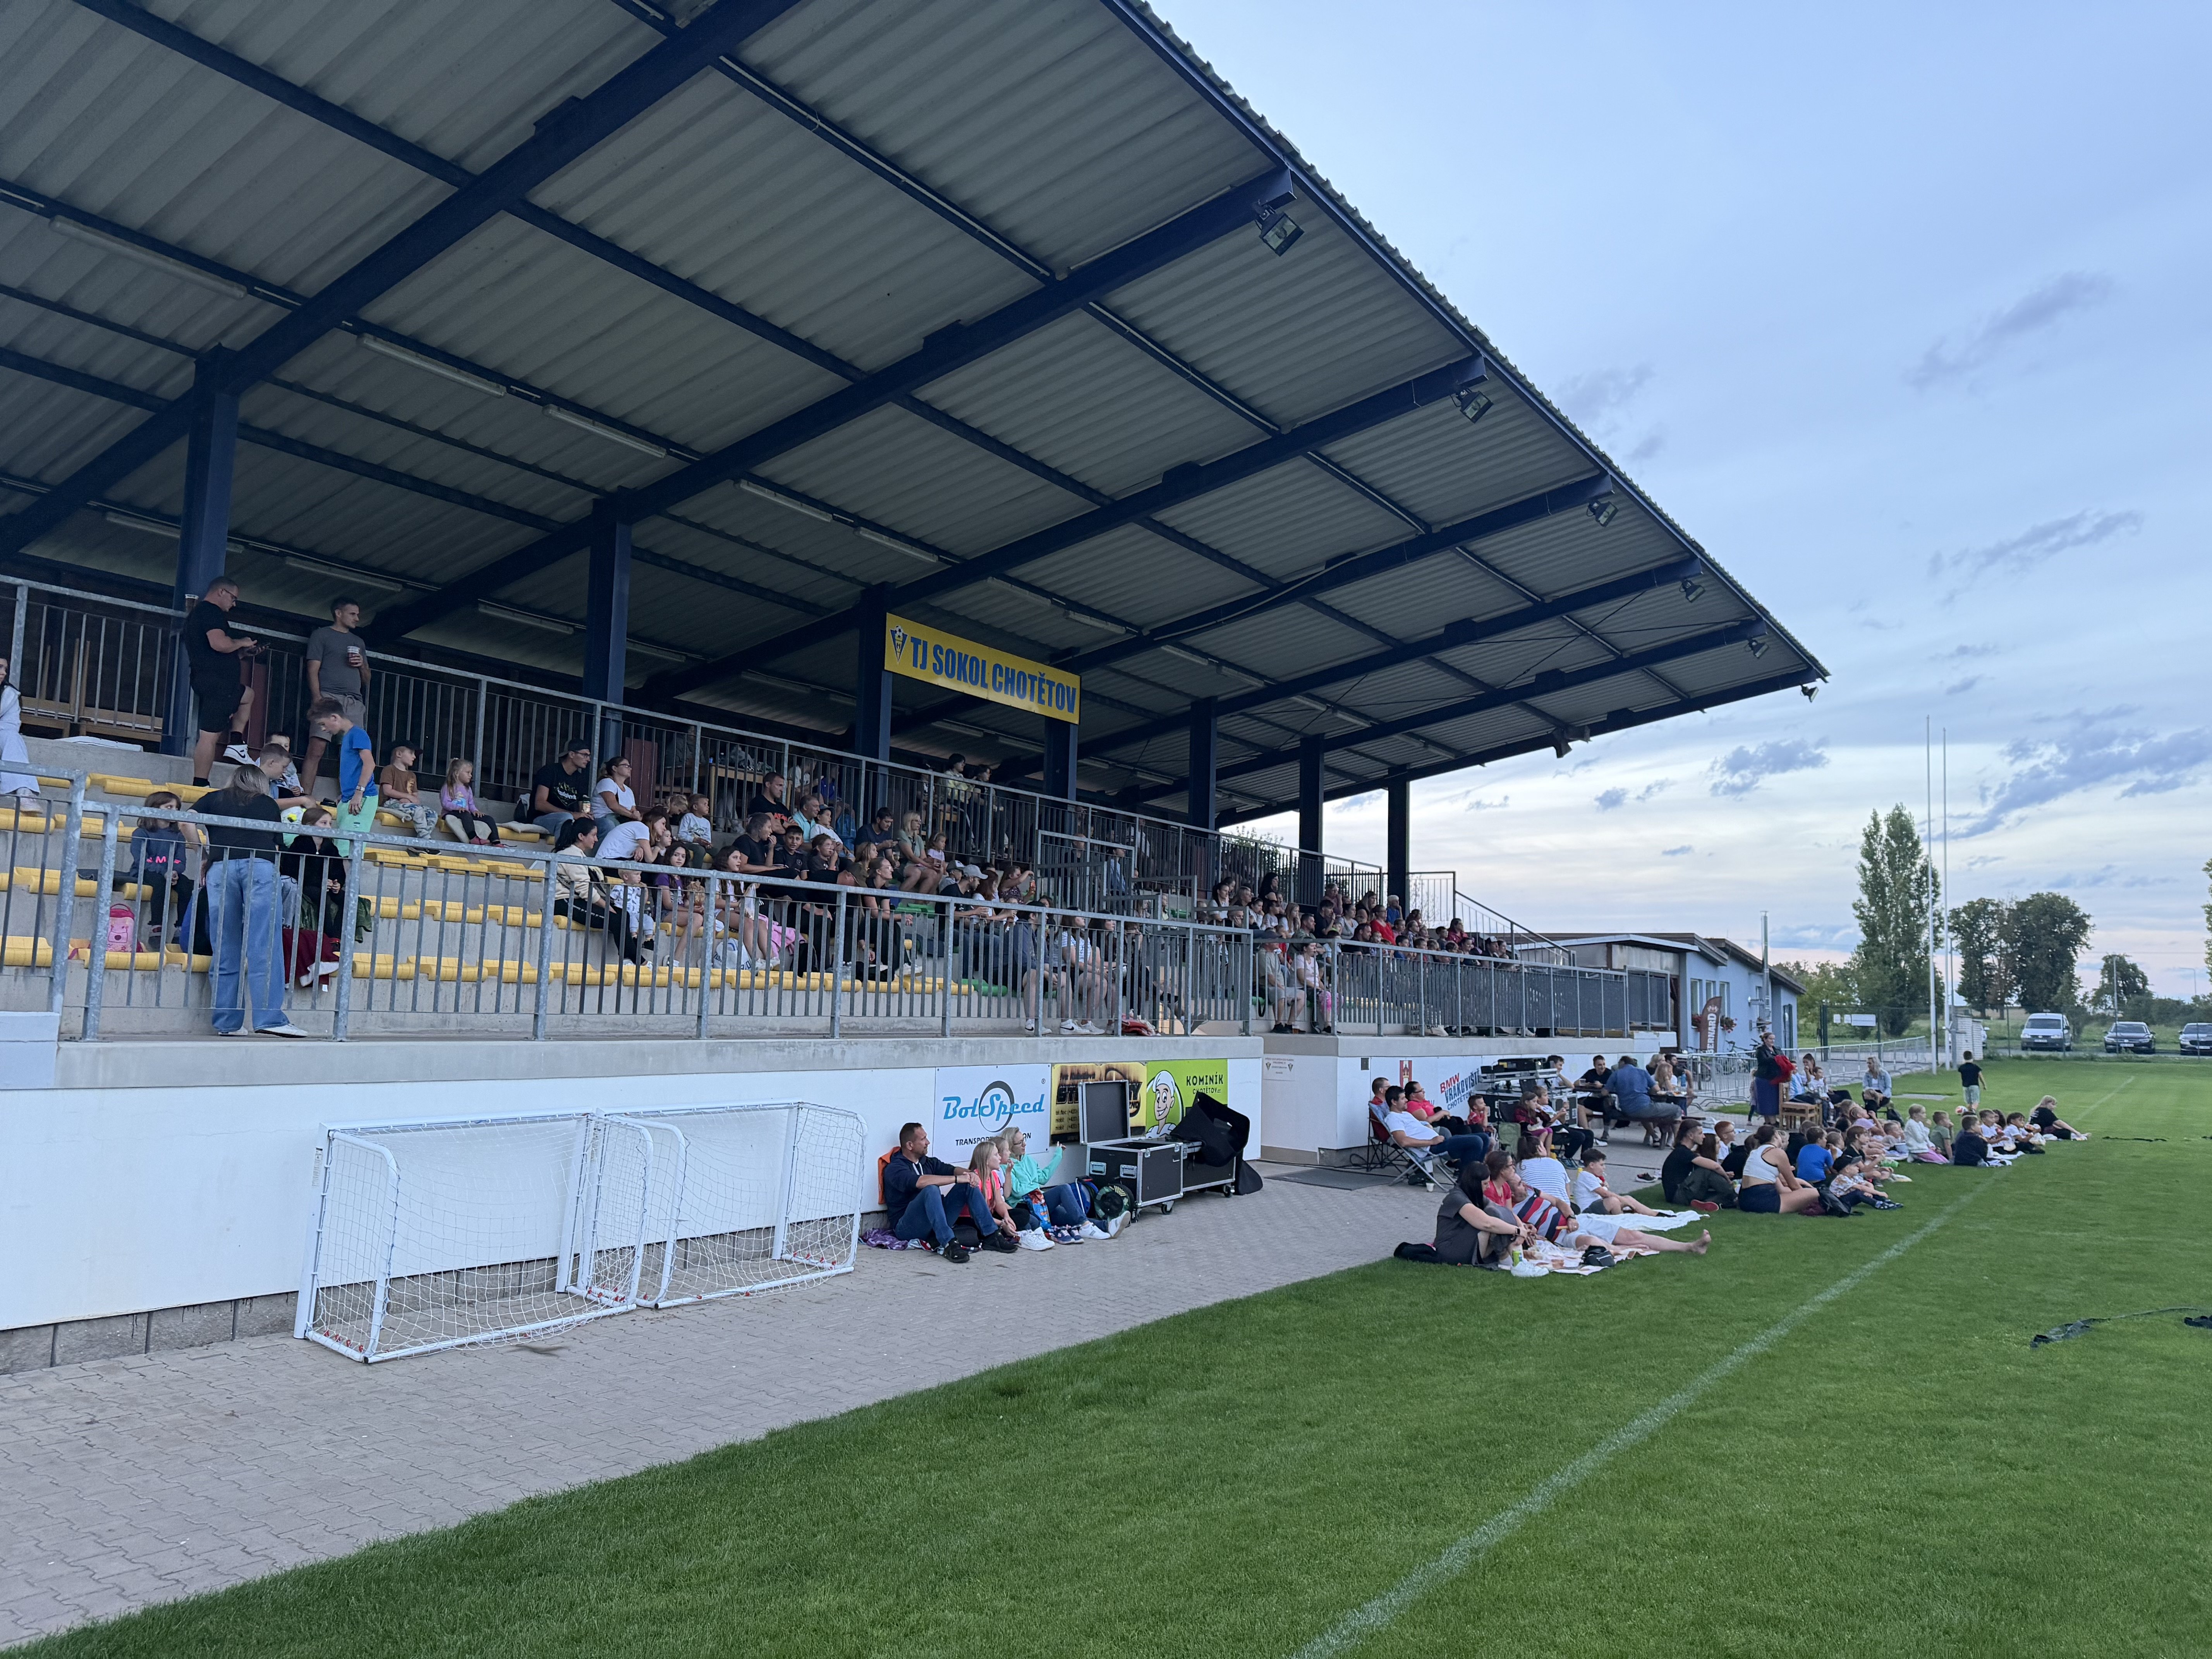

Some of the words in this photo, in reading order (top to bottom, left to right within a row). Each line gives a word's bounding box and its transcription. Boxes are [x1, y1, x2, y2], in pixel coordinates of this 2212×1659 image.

[910, 636, 928, 670] TJ
[933, 644, 988, 689] SOKOL
[992, 663, 1077, 714] CHOTĚTOV
[1707, 1013, 1716, 1053] BERNARD
[1186, 1072, 1223, 1086] KOMINÍK
[1440, 1072, 1459, 1094] BMW
[942, 1094, 1045, 1121] BolSpeed
[1447, 1090, 1472, 1110] CHOTĚTOV
